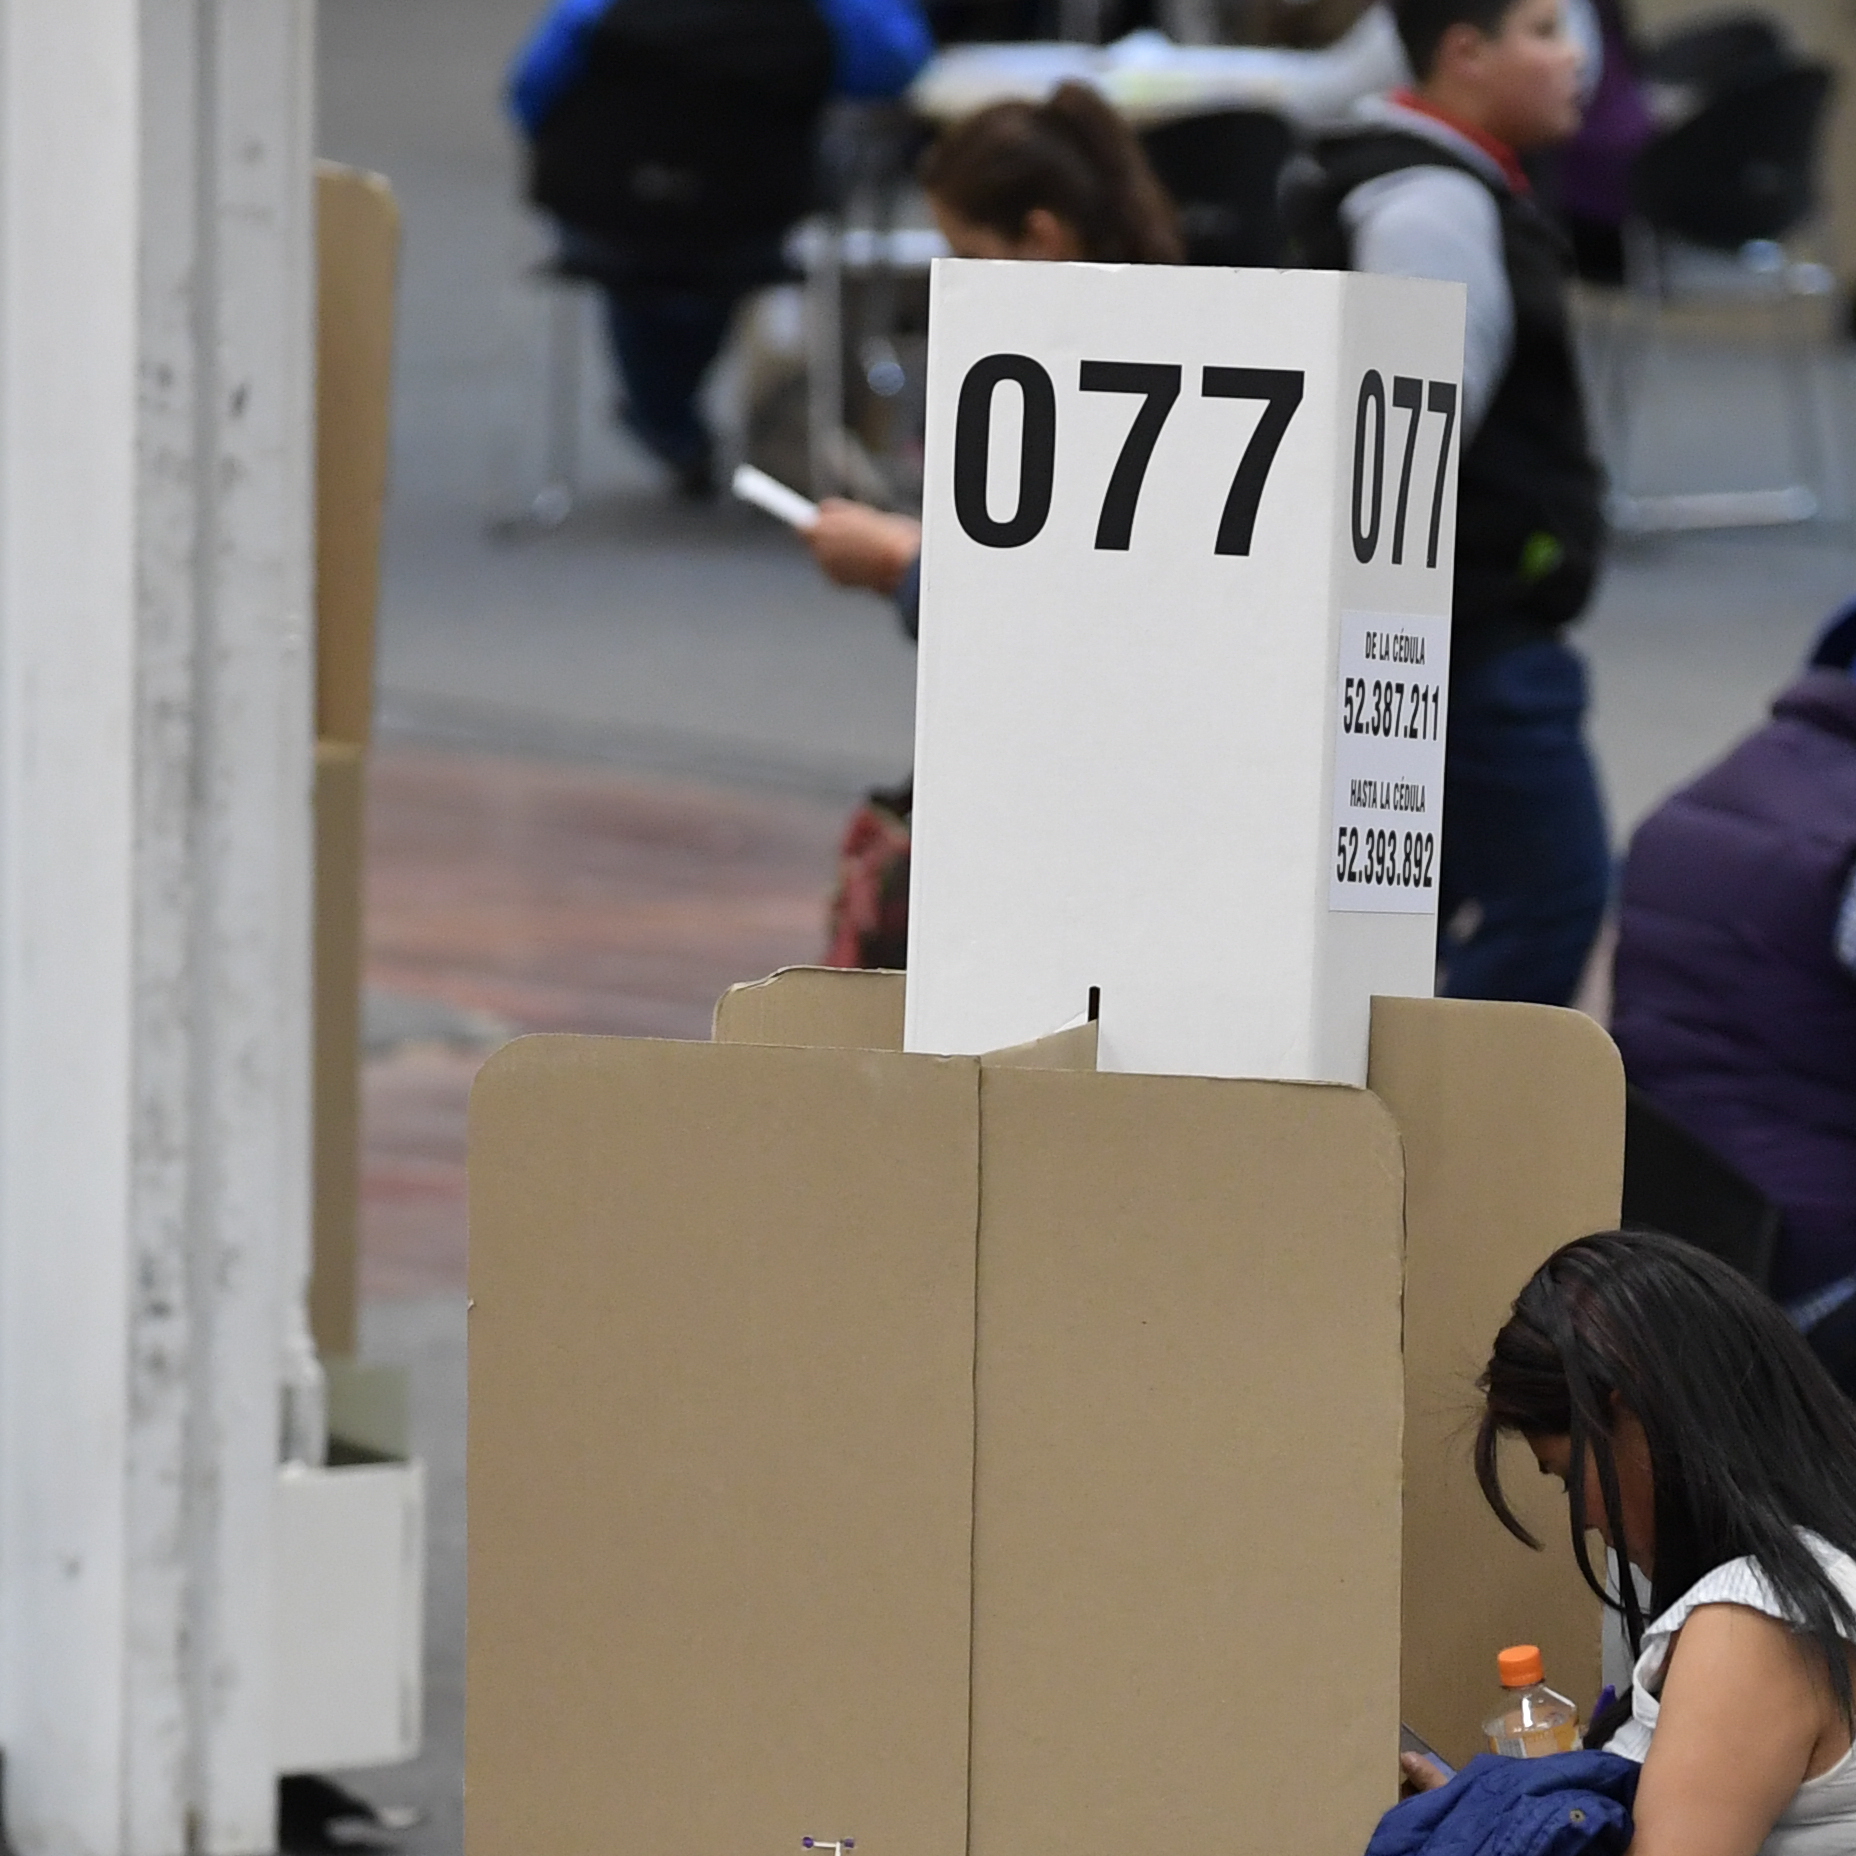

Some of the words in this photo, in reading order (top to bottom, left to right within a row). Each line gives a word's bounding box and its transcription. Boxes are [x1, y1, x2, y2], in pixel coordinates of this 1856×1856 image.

[954, 353, 1305, 556] 077
[1351, 369, 1456, 568] 077
[1365, 631, 1377, 660] DE
[1379, 633, 1390, 661] LA
[1393, 628, 1426, 665] CÉDULA
[1344, 677, 1440, 741] 52.387.211
[1350, 779, 1378, 809] HASTA
[1380, 781, 1391, 810] LA
[1393, 776, 1426, 813] CÉDULA
[1336, 826, 1434, 888] 52.393.892
